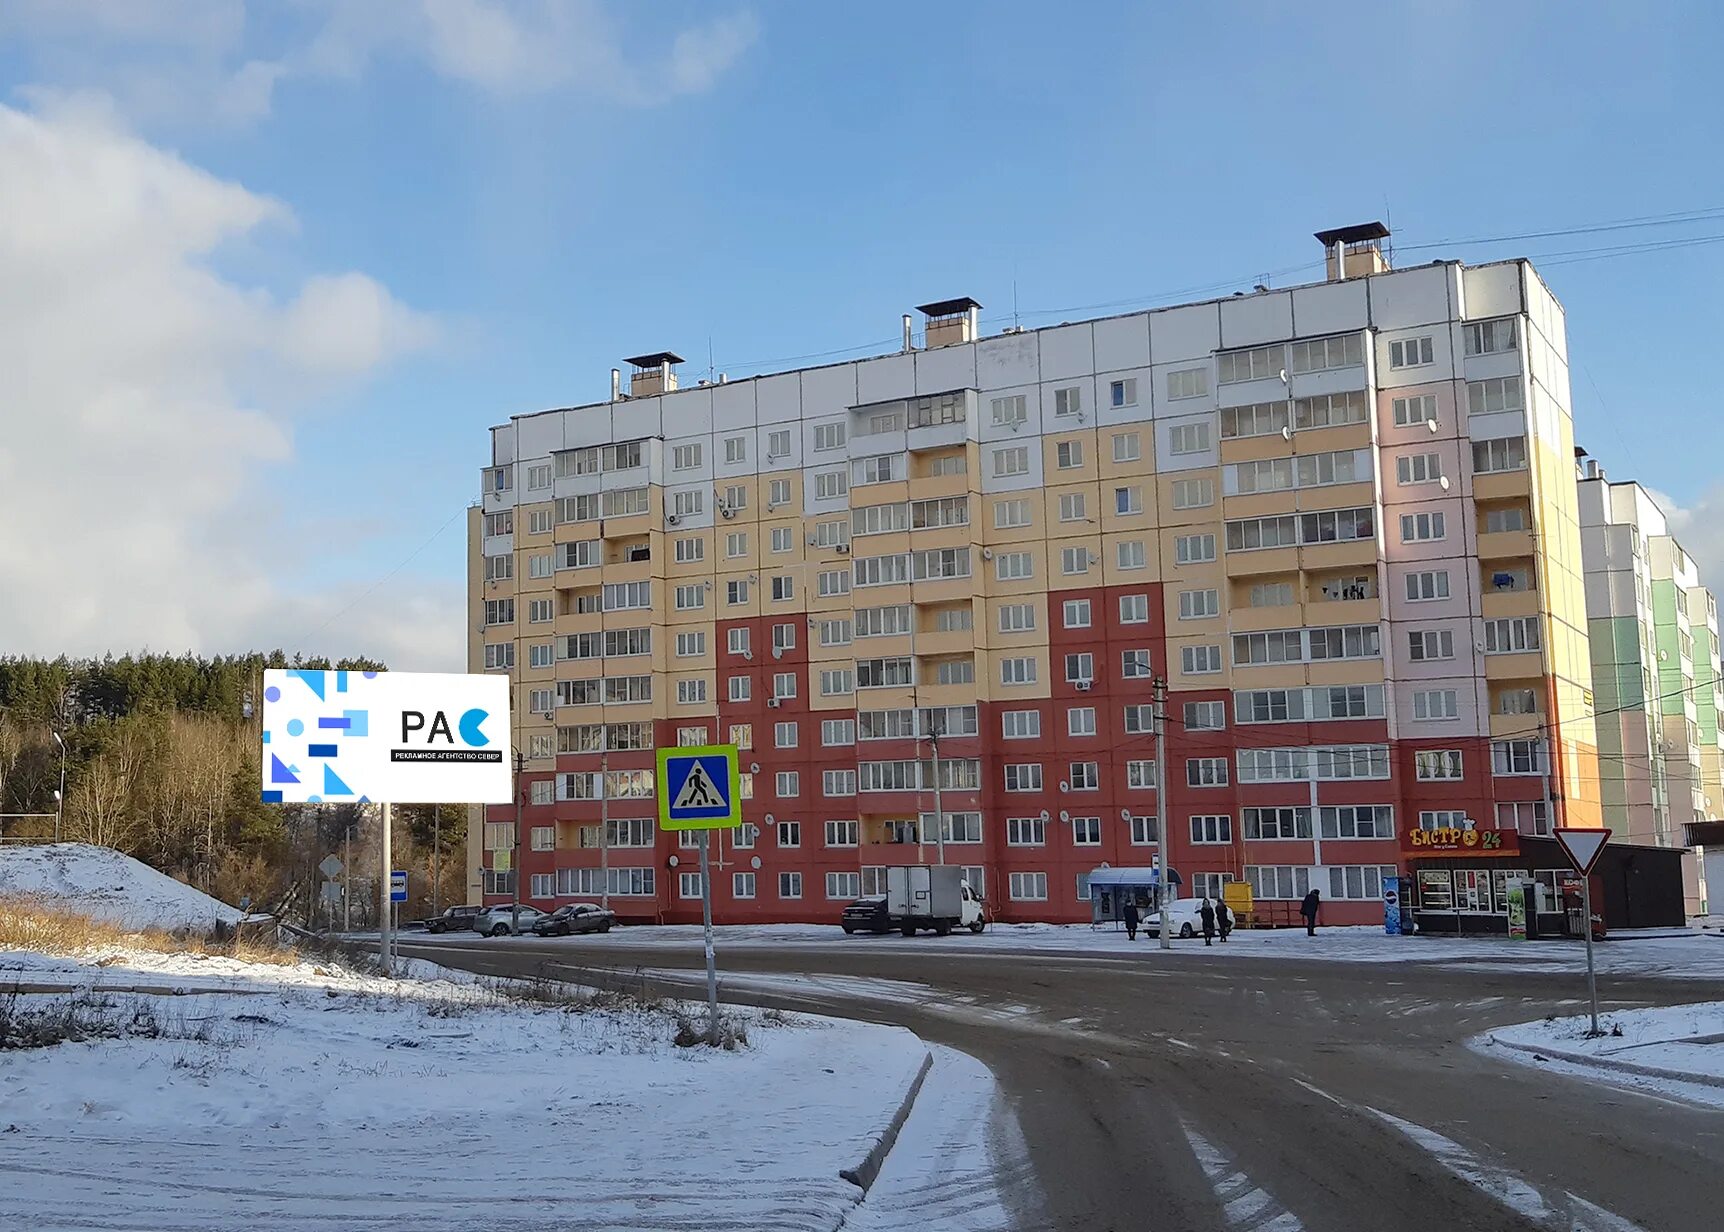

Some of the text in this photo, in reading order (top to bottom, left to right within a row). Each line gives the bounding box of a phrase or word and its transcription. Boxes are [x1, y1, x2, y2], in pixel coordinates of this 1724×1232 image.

[401, 708, 490, 747] РАС
[395, 752, 436, 760] РЕКЛАМНОЕ
[437, 752, 477, 760] АГЕНТСТВО
[1409, 828, 1502, 849] БИСТРО 24
